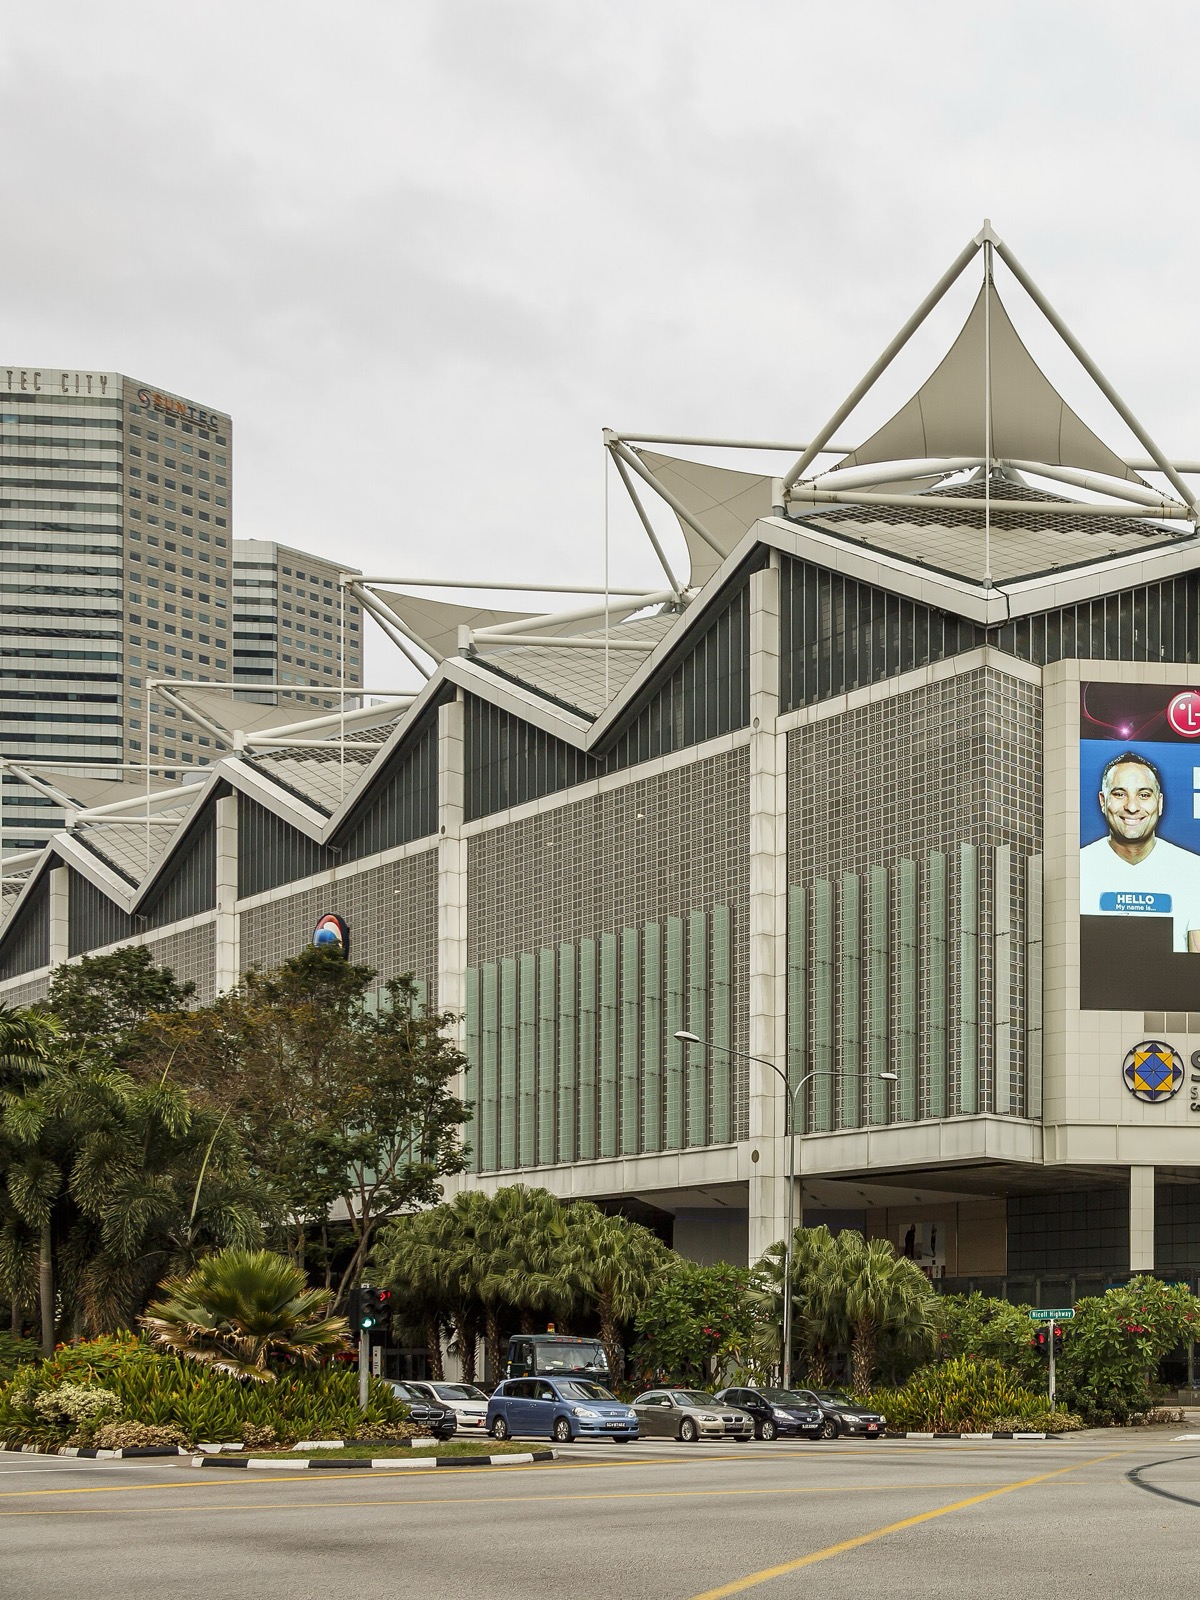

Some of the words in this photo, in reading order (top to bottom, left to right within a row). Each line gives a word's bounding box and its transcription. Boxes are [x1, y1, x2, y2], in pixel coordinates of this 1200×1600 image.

[6, 370, 42, 391] TEC
[61, 373, 108, 395] CITY
[153, 393, 219, 427] SUNTEC
[1117, 894, 1155, 905] HELLO
[1031, 1310, 1048, 1318] Nicoll
[1049, 1310, 1072, 1319] Highway
